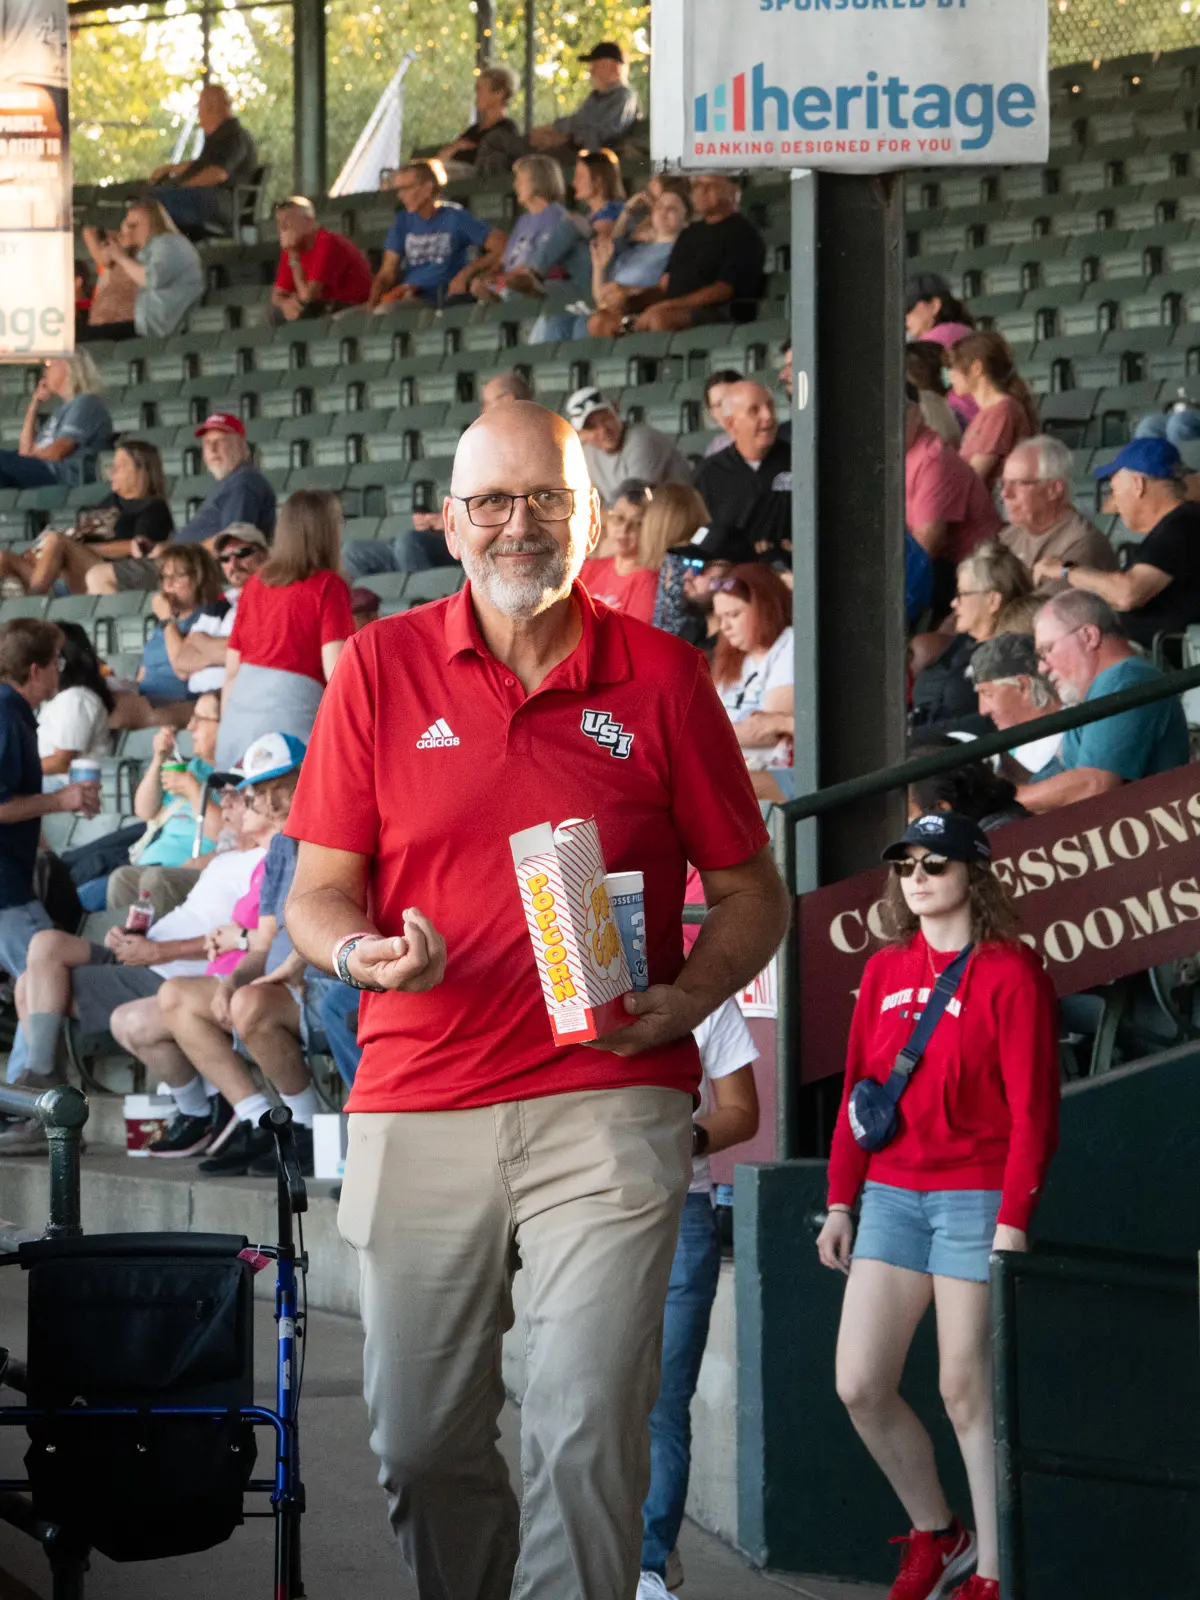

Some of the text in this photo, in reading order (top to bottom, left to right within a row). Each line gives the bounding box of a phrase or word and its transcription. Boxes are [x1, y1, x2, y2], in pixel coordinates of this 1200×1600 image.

[752, 62, 1036, 150] heritage
[694, 139, 951, 155] BANKING DESIGNED FOR YOU
[416, 735, 460, 749] adidas
[580, 709, 635, 760] USI
[526, 873, 578, 1003] POPCORN
